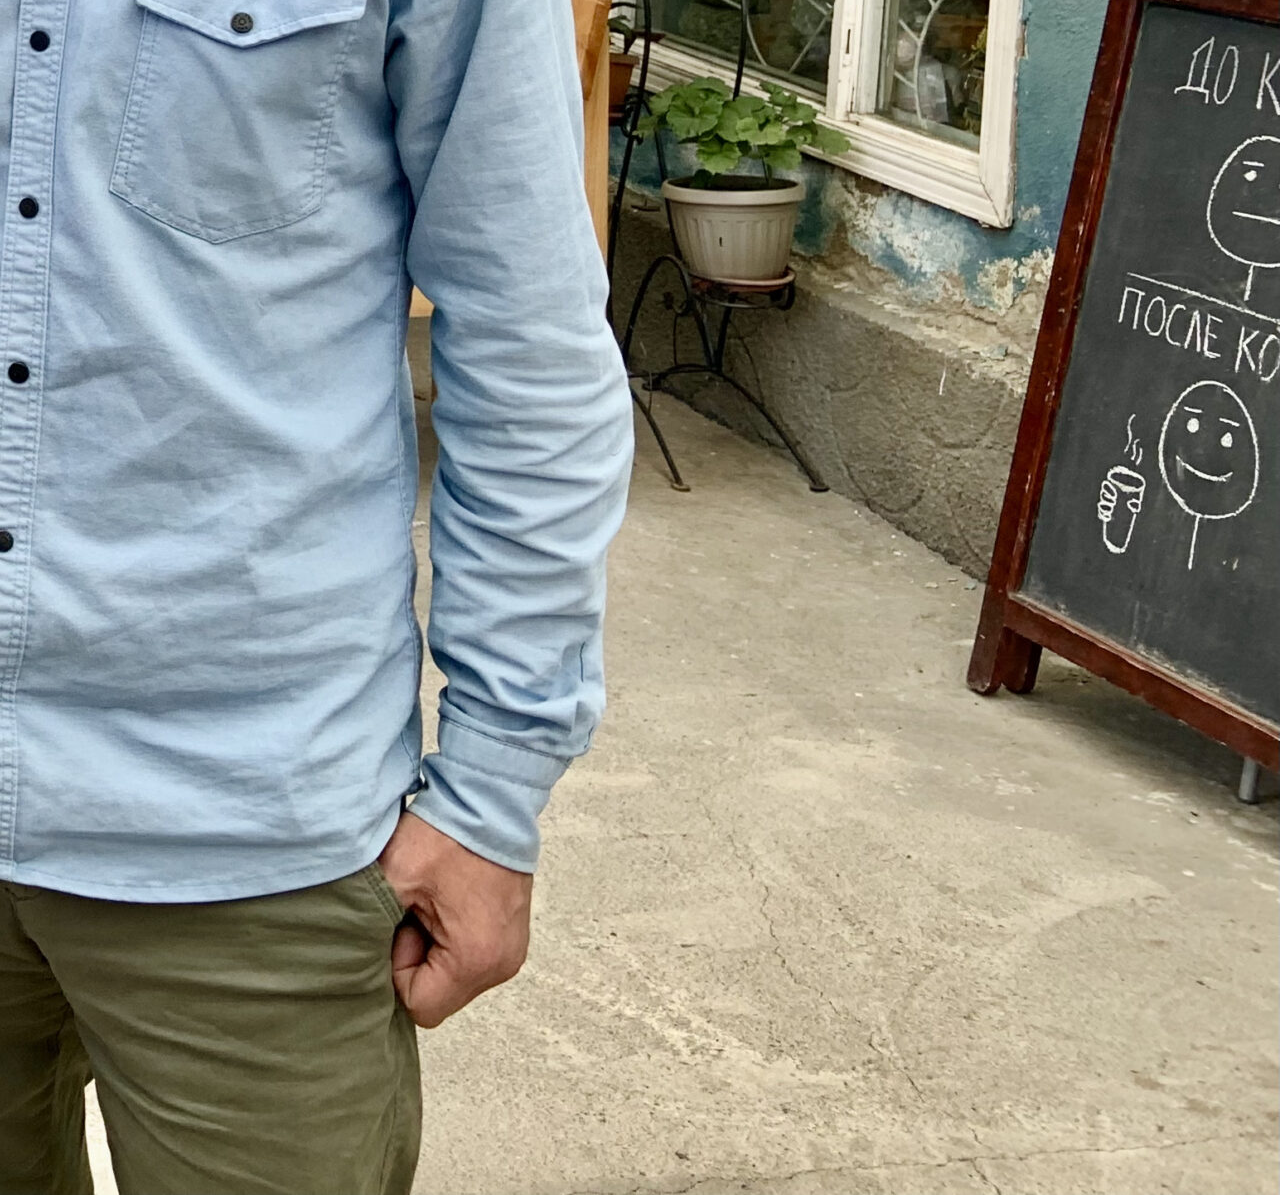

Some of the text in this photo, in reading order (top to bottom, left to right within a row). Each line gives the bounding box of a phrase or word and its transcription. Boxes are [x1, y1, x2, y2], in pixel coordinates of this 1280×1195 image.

[1173, 35, 1240, 105] ДО
[1118, 282, 1280, 383] ПОСЛЕ КО
